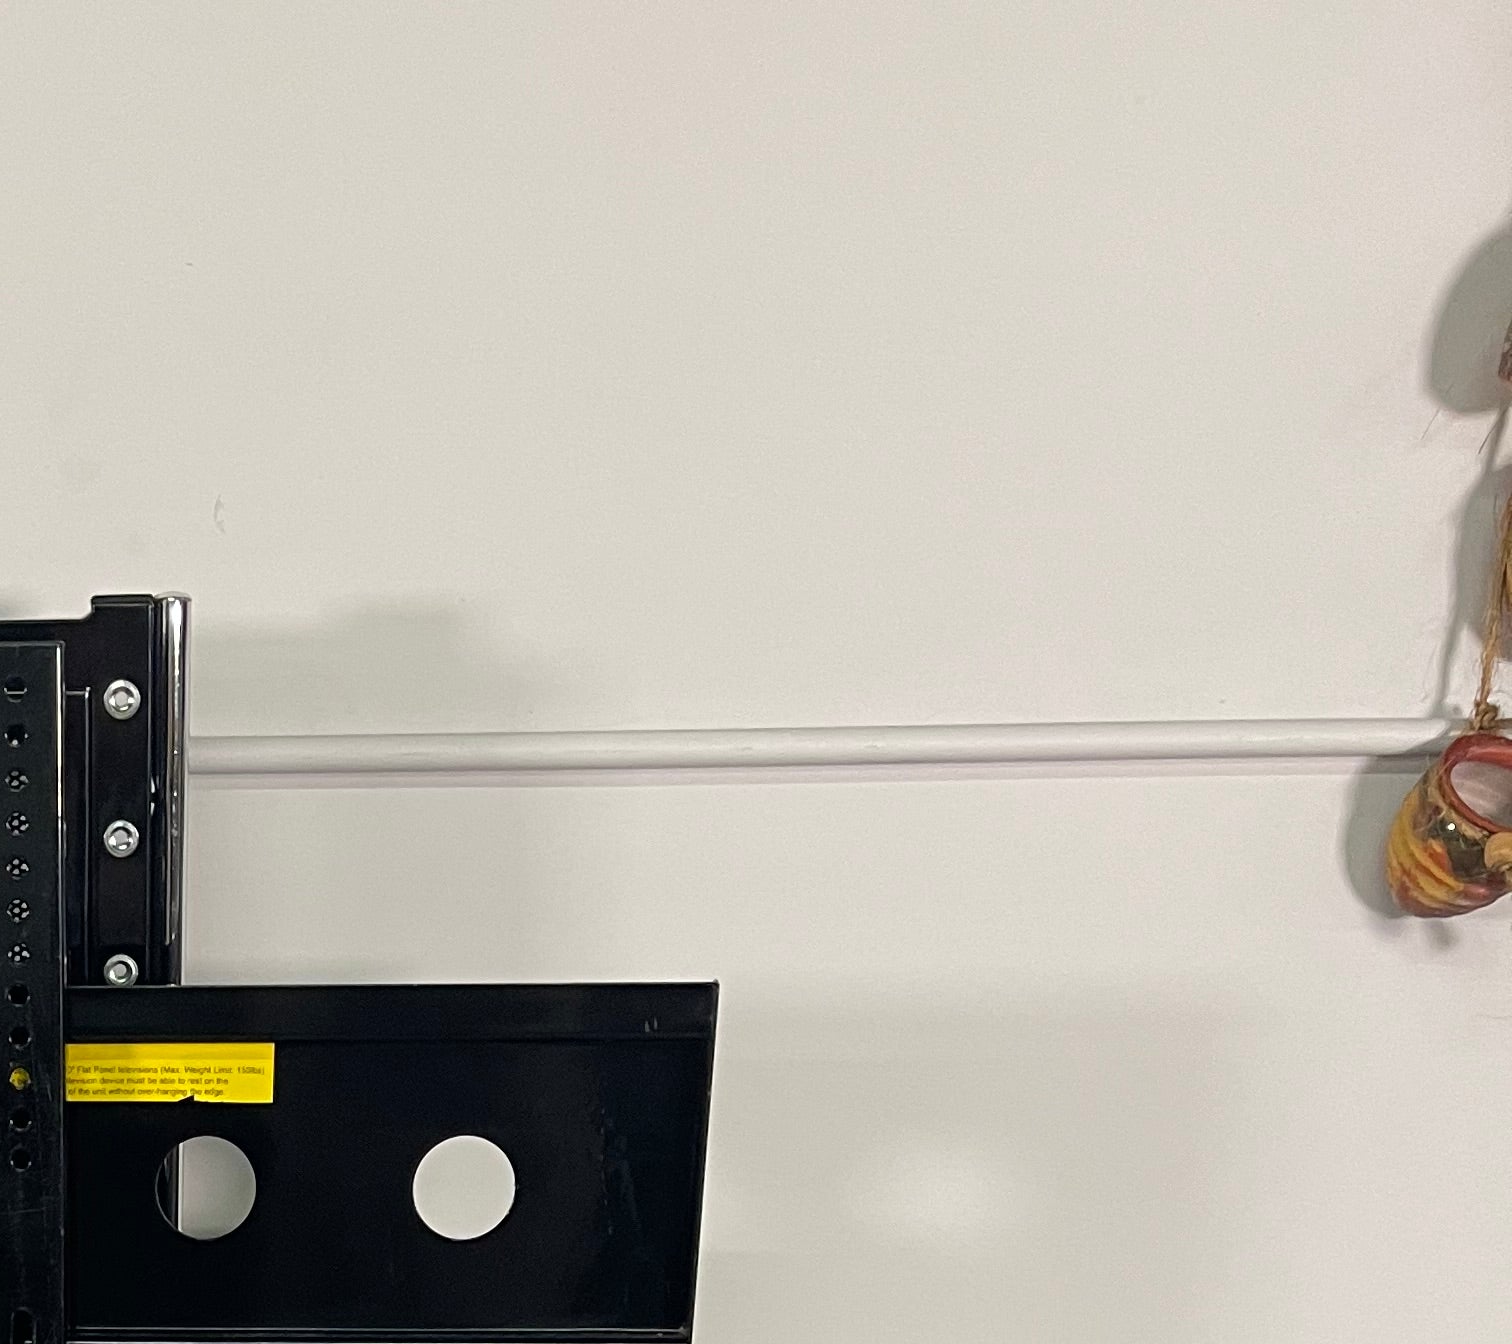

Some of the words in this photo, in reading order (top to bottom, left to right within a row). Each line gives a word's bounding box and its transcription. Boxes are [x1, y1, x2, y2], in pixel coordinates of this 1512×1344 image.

[184, 1065, 212, 1076] Weight
[148, 1077, 158, 1085] be
[178, 1077, 186, 1085] to
[216, 1077, 229, 1086] the
[78, 1087, 91, 1096] the
